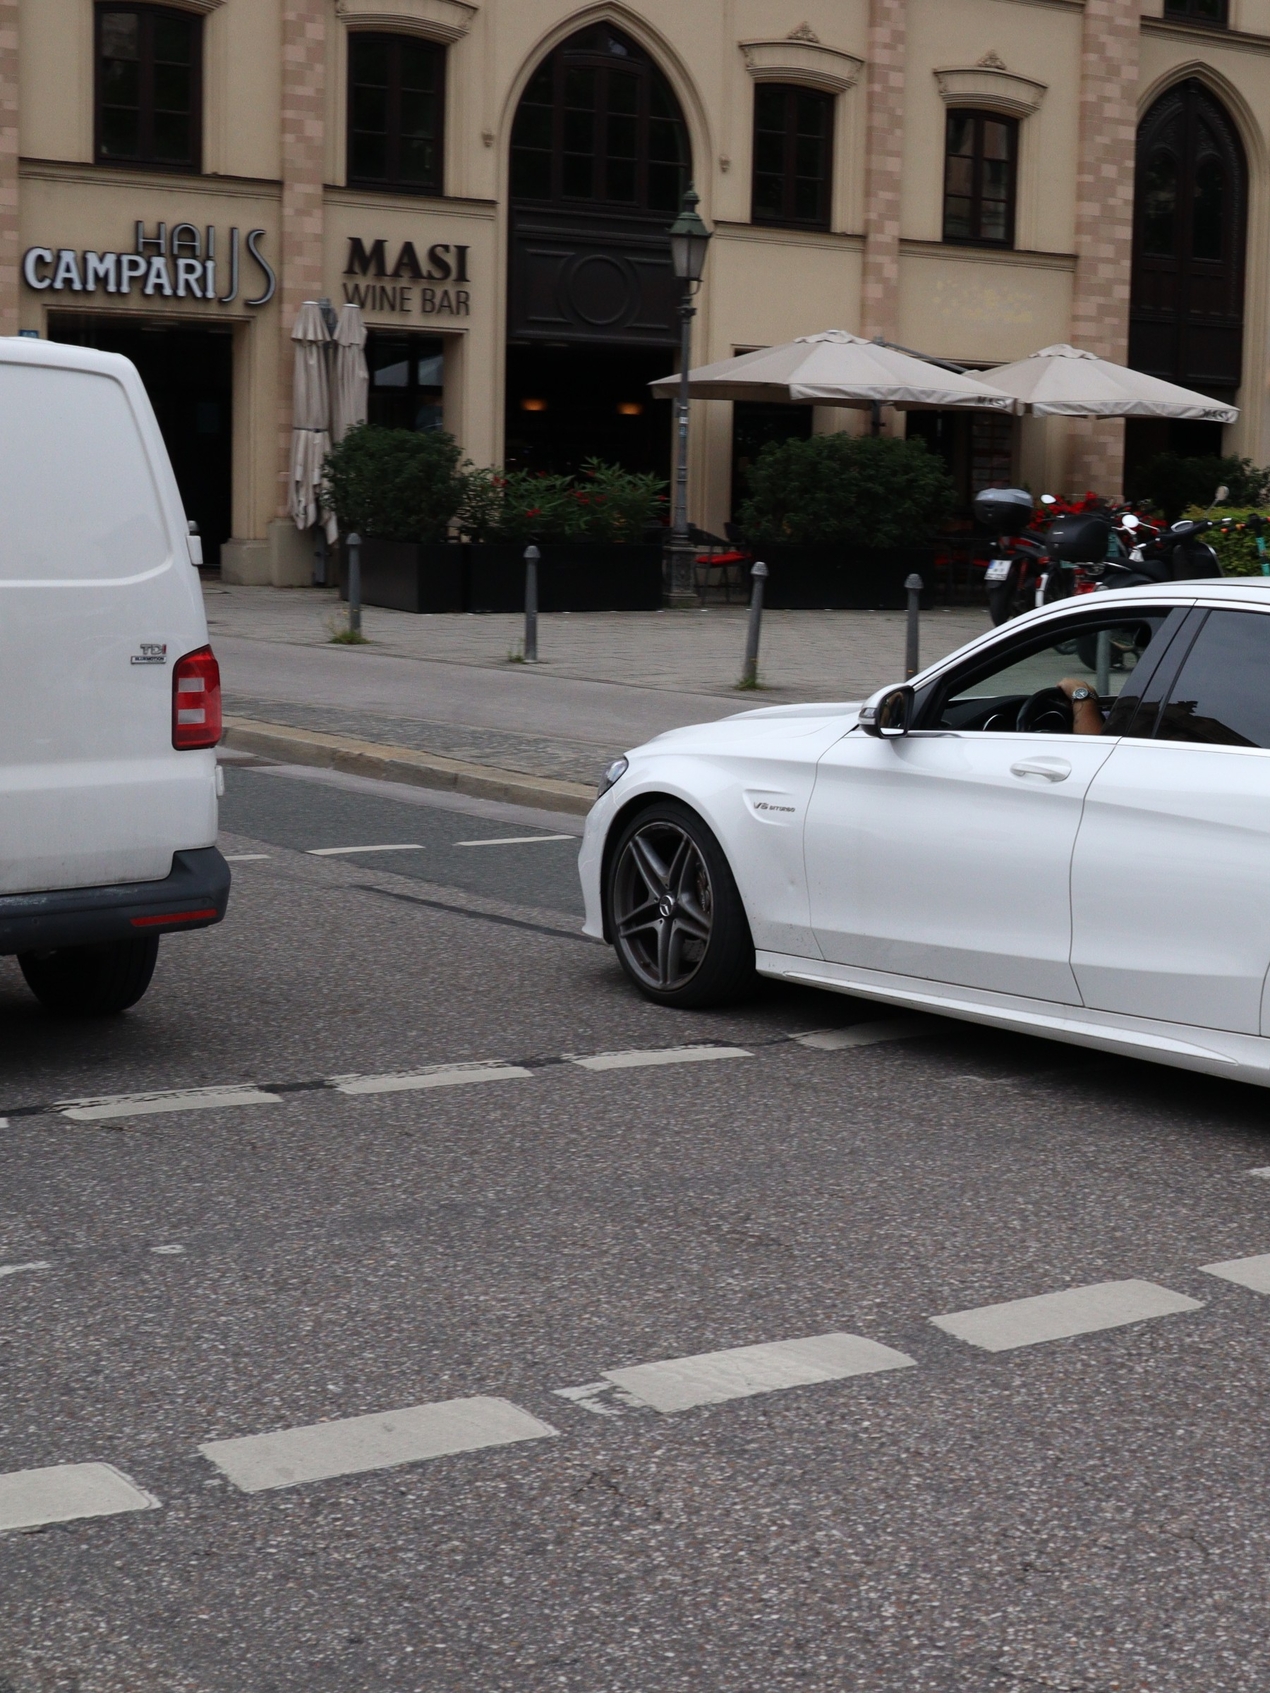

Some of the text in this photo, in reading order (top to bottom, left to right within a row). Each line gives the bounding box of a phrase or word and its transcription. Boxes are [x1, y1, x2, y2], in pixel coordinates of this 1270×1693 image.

[24, 246, 216, 299] CAMPARI
[343, 236, 471, 282] MASI
[342, 282, 470, 316] WINE BAR
[140, 643, 167, 655] TDI
